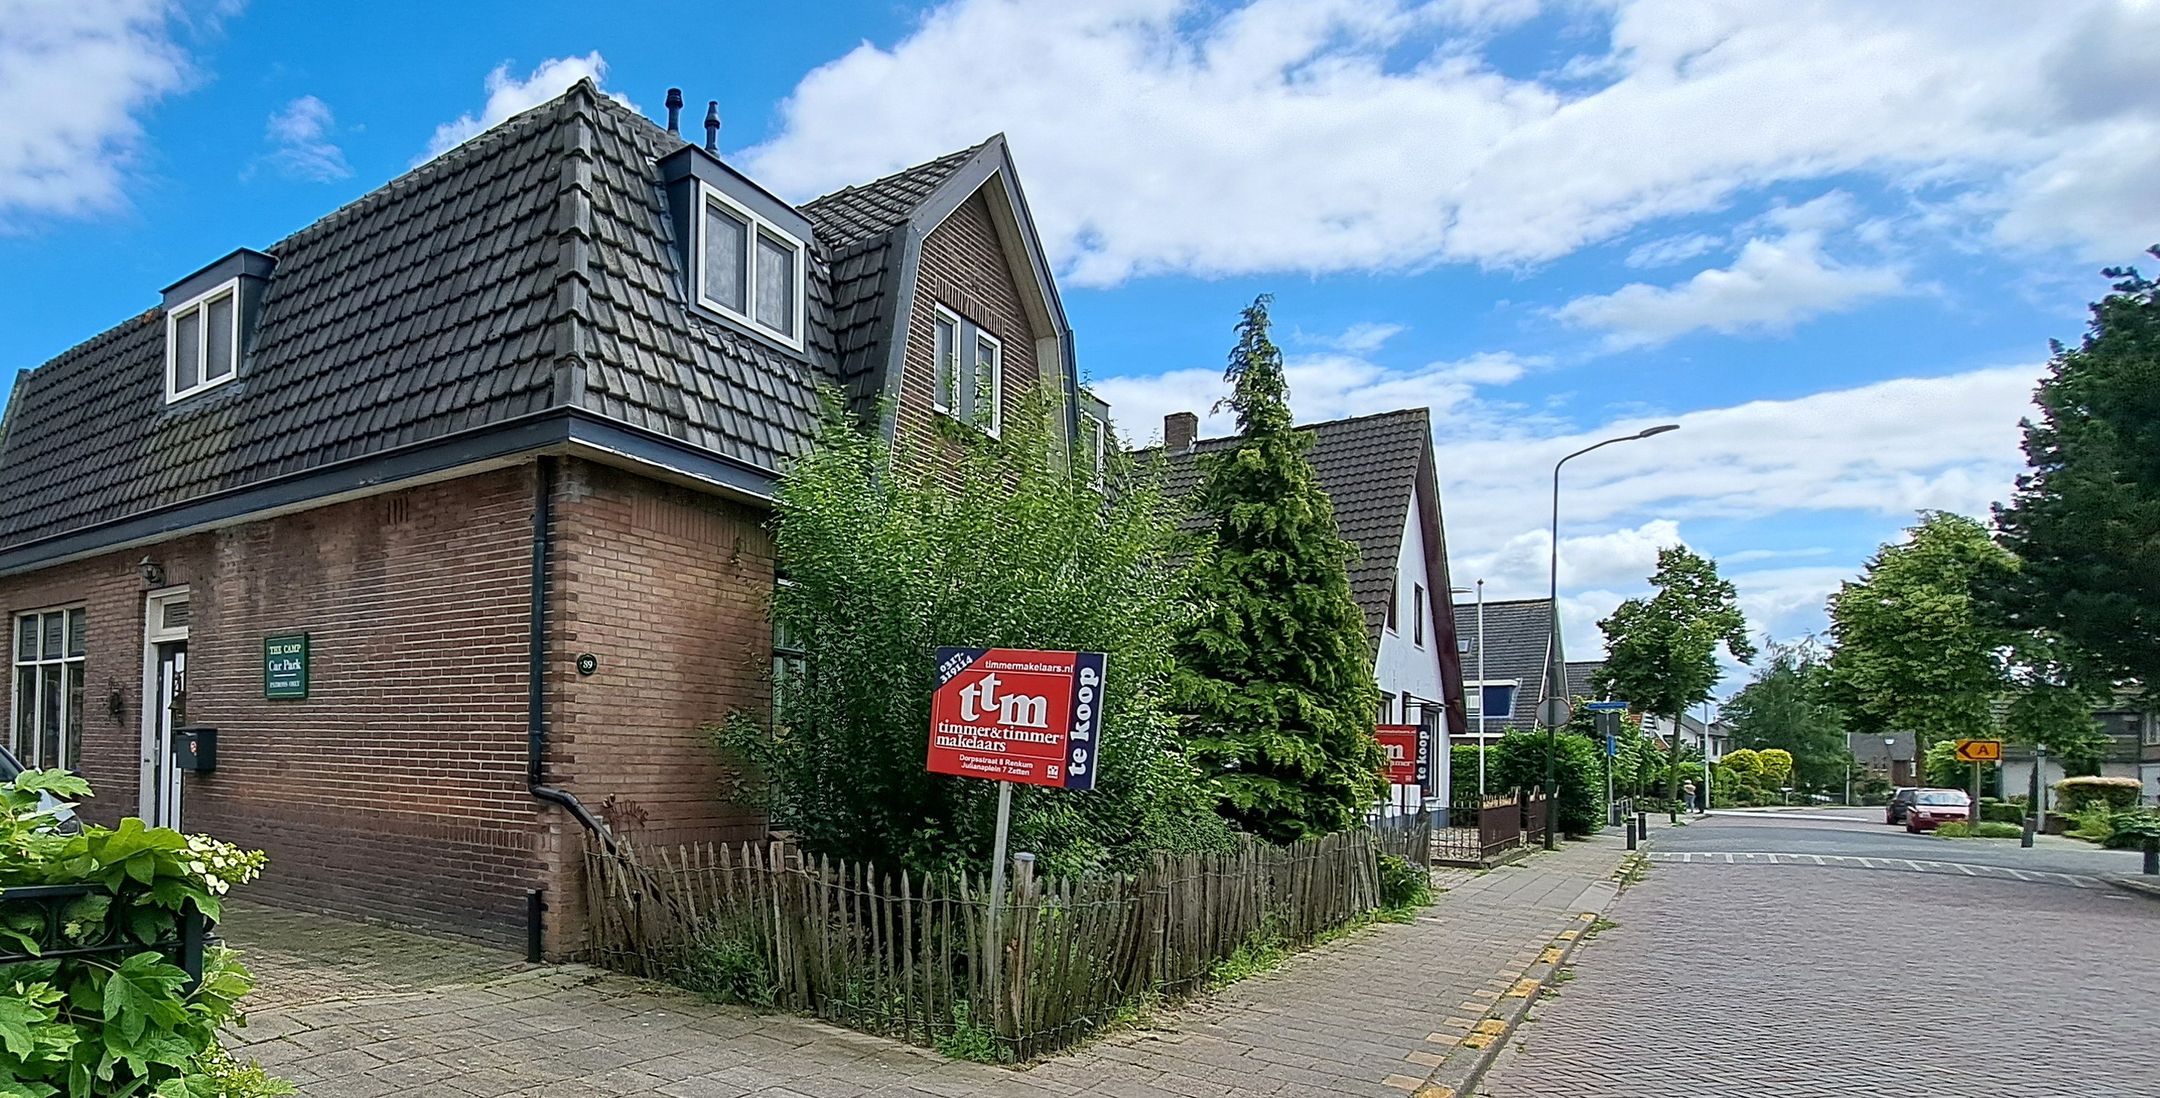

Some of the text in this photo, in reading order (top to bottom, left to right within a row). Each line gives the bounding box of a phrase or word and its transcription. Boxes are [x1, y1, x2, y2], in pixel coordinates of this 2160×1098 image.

[269, 644, 301, 654] THE CAMP
[268, 659, 301, 671] Car Park
[939, 652, 965, 673] 0317-
[939, 655, 973, 684] 319114
[985, 660, 1074, 673] timmermakelaars.nl
[959, 672, 1049, 729] ttm
[1068, 667, 1099, 777] te koop
[936, 735, 1006, 752] makelaars
[1977, 745, 1989, 755] A
[959, 754, 998, 765] Dorpsstraat
[1005, 760, 1034, 769] Renkum
[1416, 731, 1430, 780] te koop
[961, 762, 1001, 773] Julianaplein
[1008, 767, 1030, 776] Zetten
